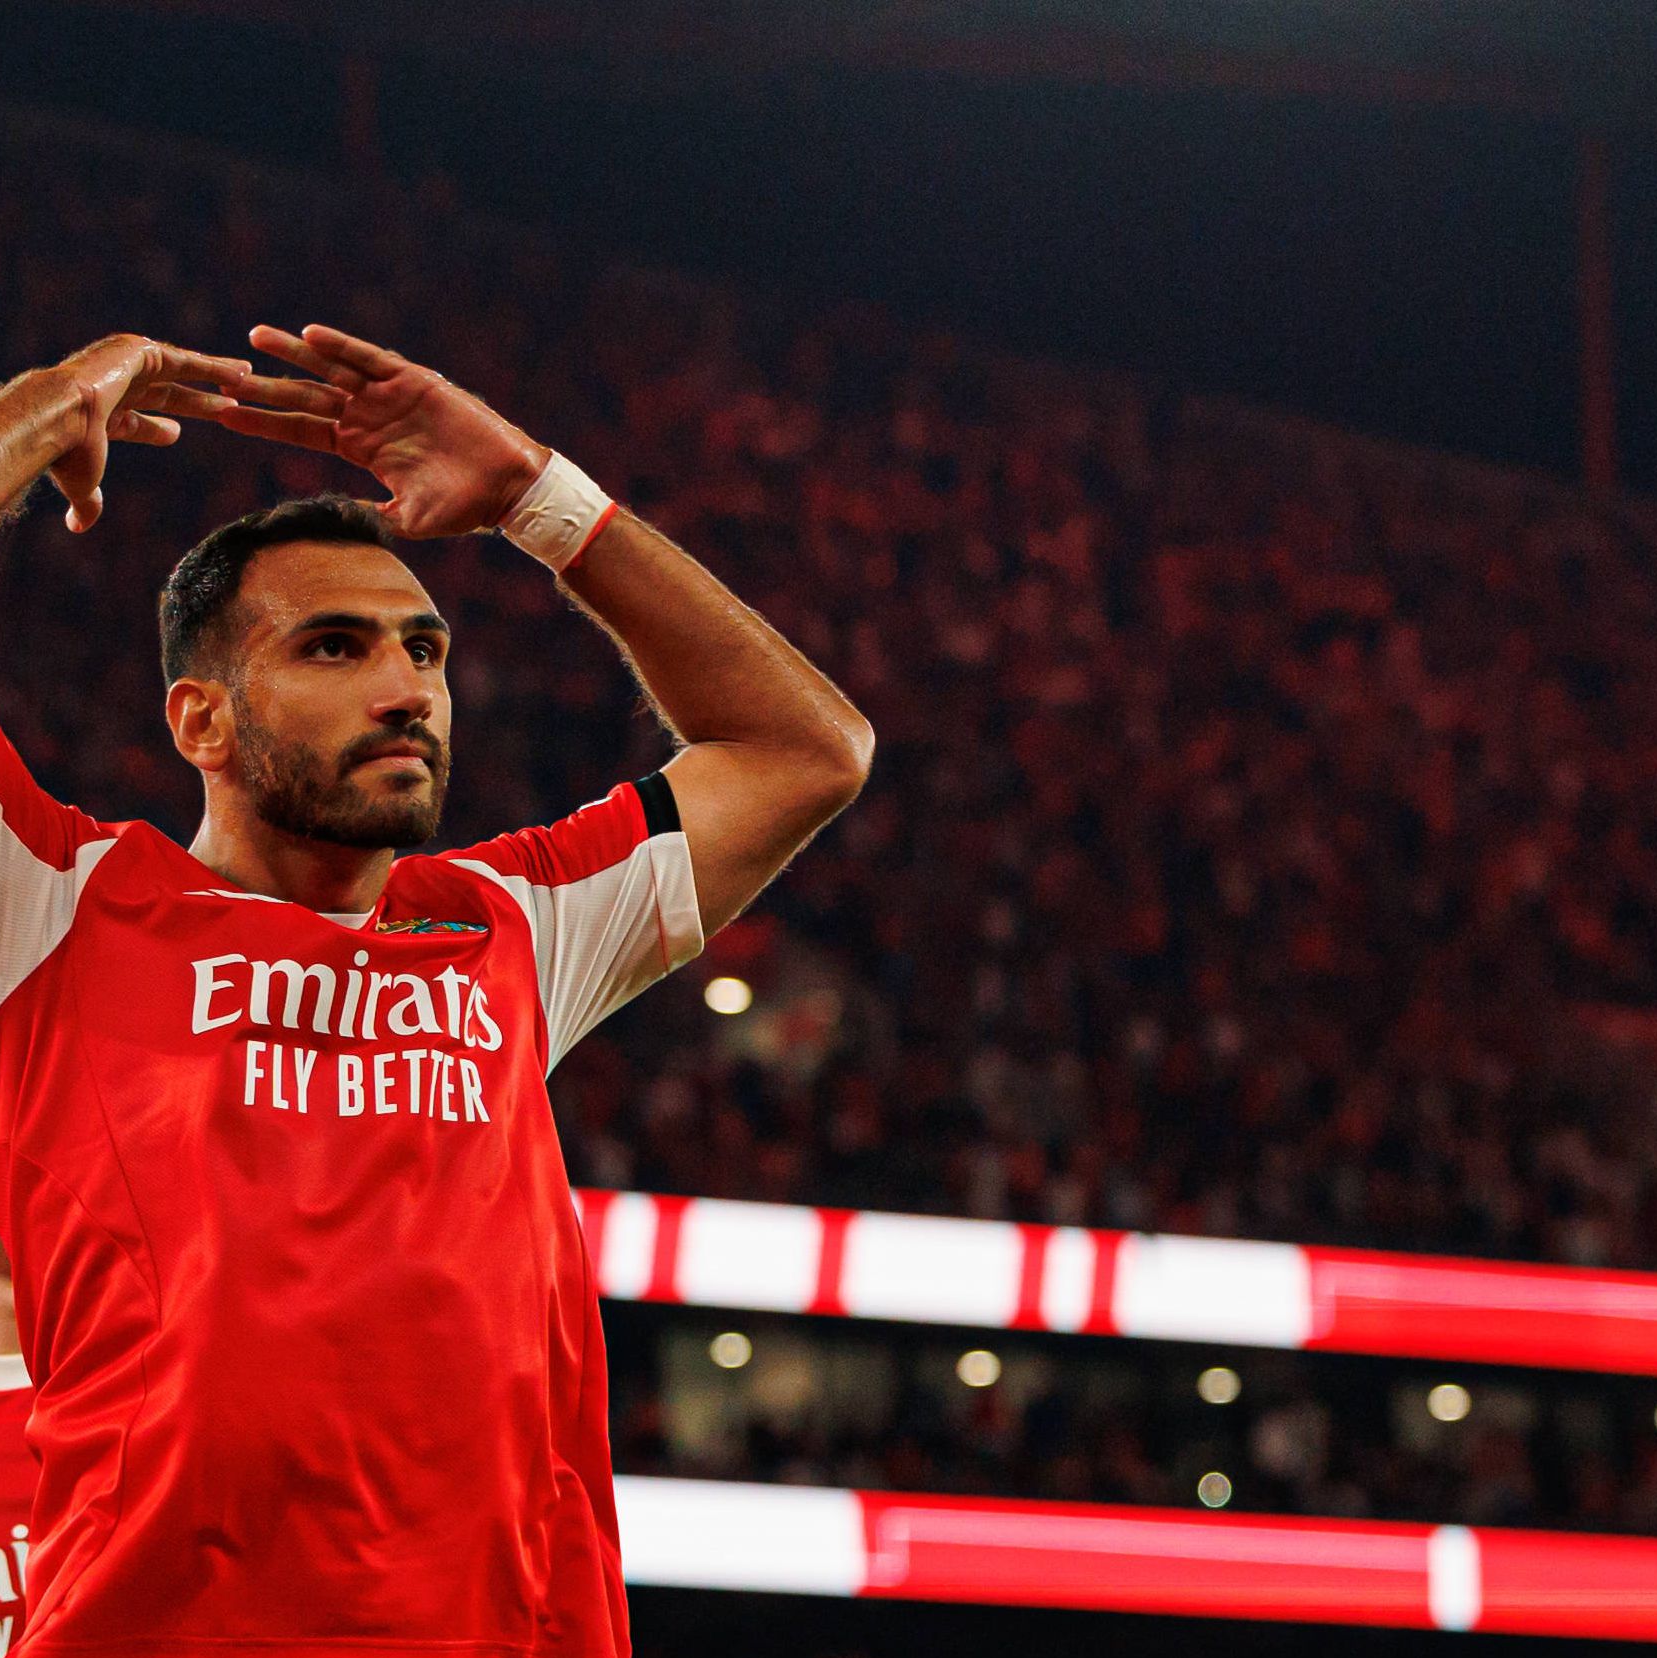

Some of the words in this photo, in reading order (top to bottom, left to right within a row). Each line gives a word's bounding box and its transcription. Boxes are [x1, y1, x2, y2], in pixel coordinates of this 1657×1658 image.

[190, 950, 503, 1052] Emirates
[244, 1041, 316, 1114] FLY
[338, 1048, 491, 1123] BETTER
